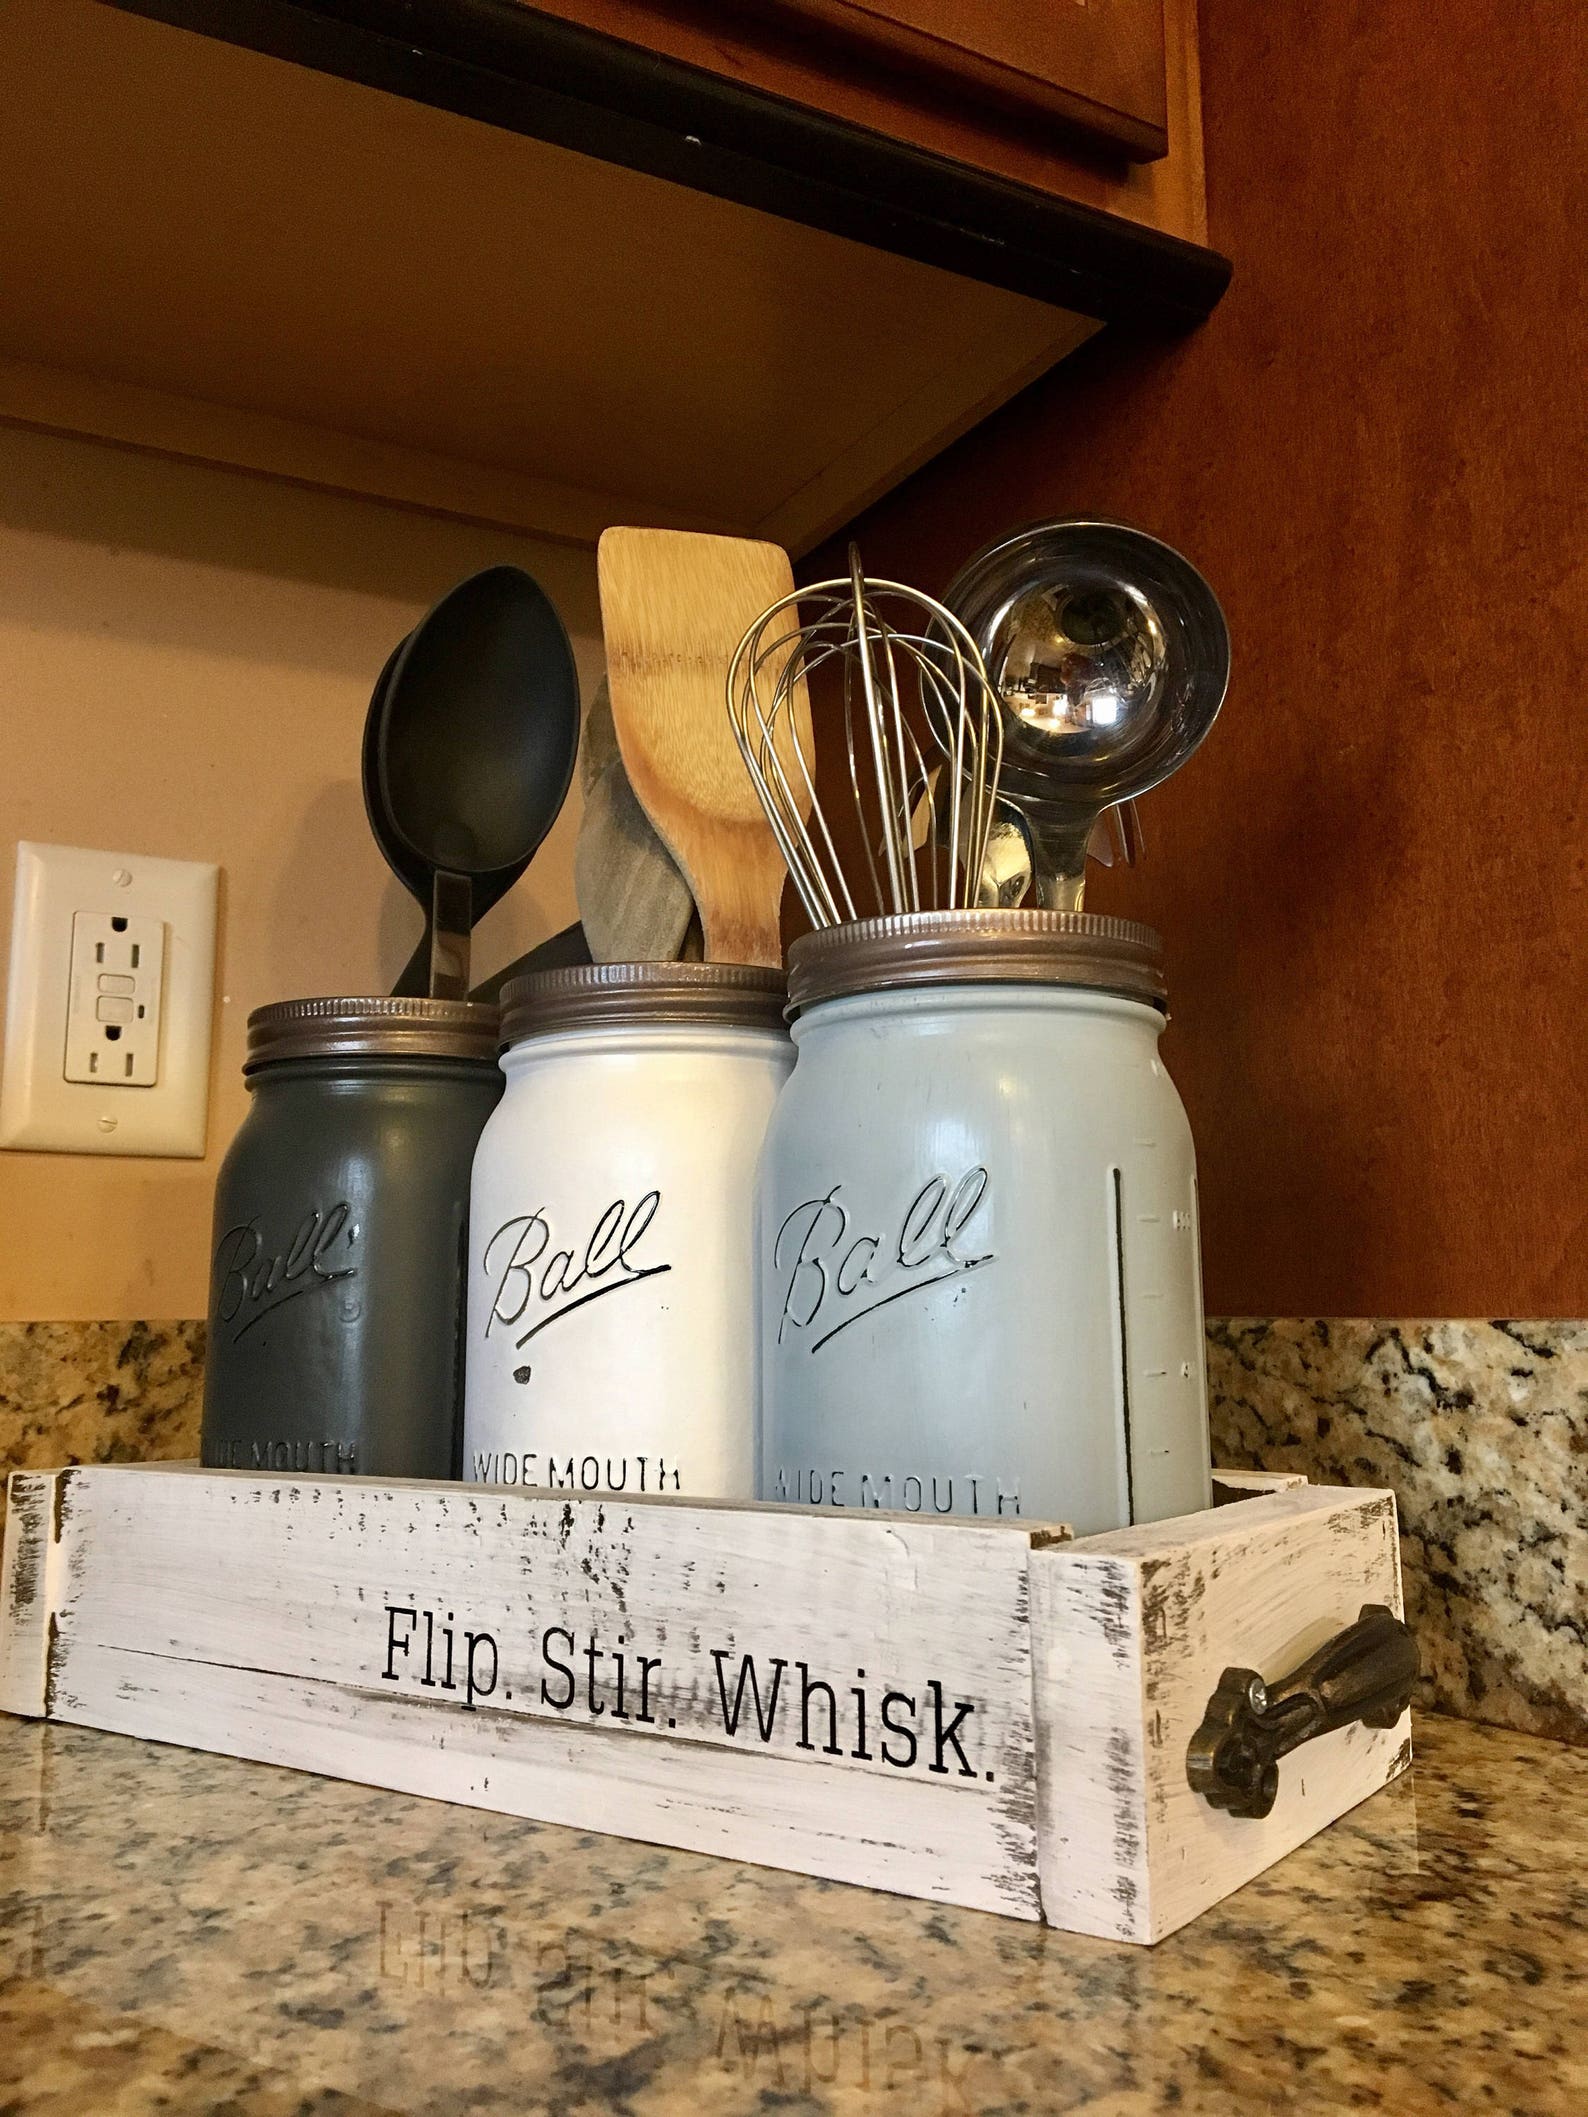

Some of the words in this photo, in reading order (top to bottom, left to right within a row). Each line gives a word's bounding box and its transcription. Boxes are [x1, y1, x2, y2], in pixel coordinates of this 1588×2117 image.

[213, 1201, 356, 1344] Ball
[483, 1190, 672, 1350] Ball
[774, 1166, 1000, 1354] Ball
[473, 1453, 538, 1488] WIDE
[549, 1455, 681, 1492] MOUTH
[775, 1469, 844, 1507] WIDE
[862, 1473, 1021, 1515] MOUTH
[381, 1605, 513, 1711] Flip.
[541, 1625, 677, 1729] Stir.
[711, 1648, 996, 1783] Whisk.
